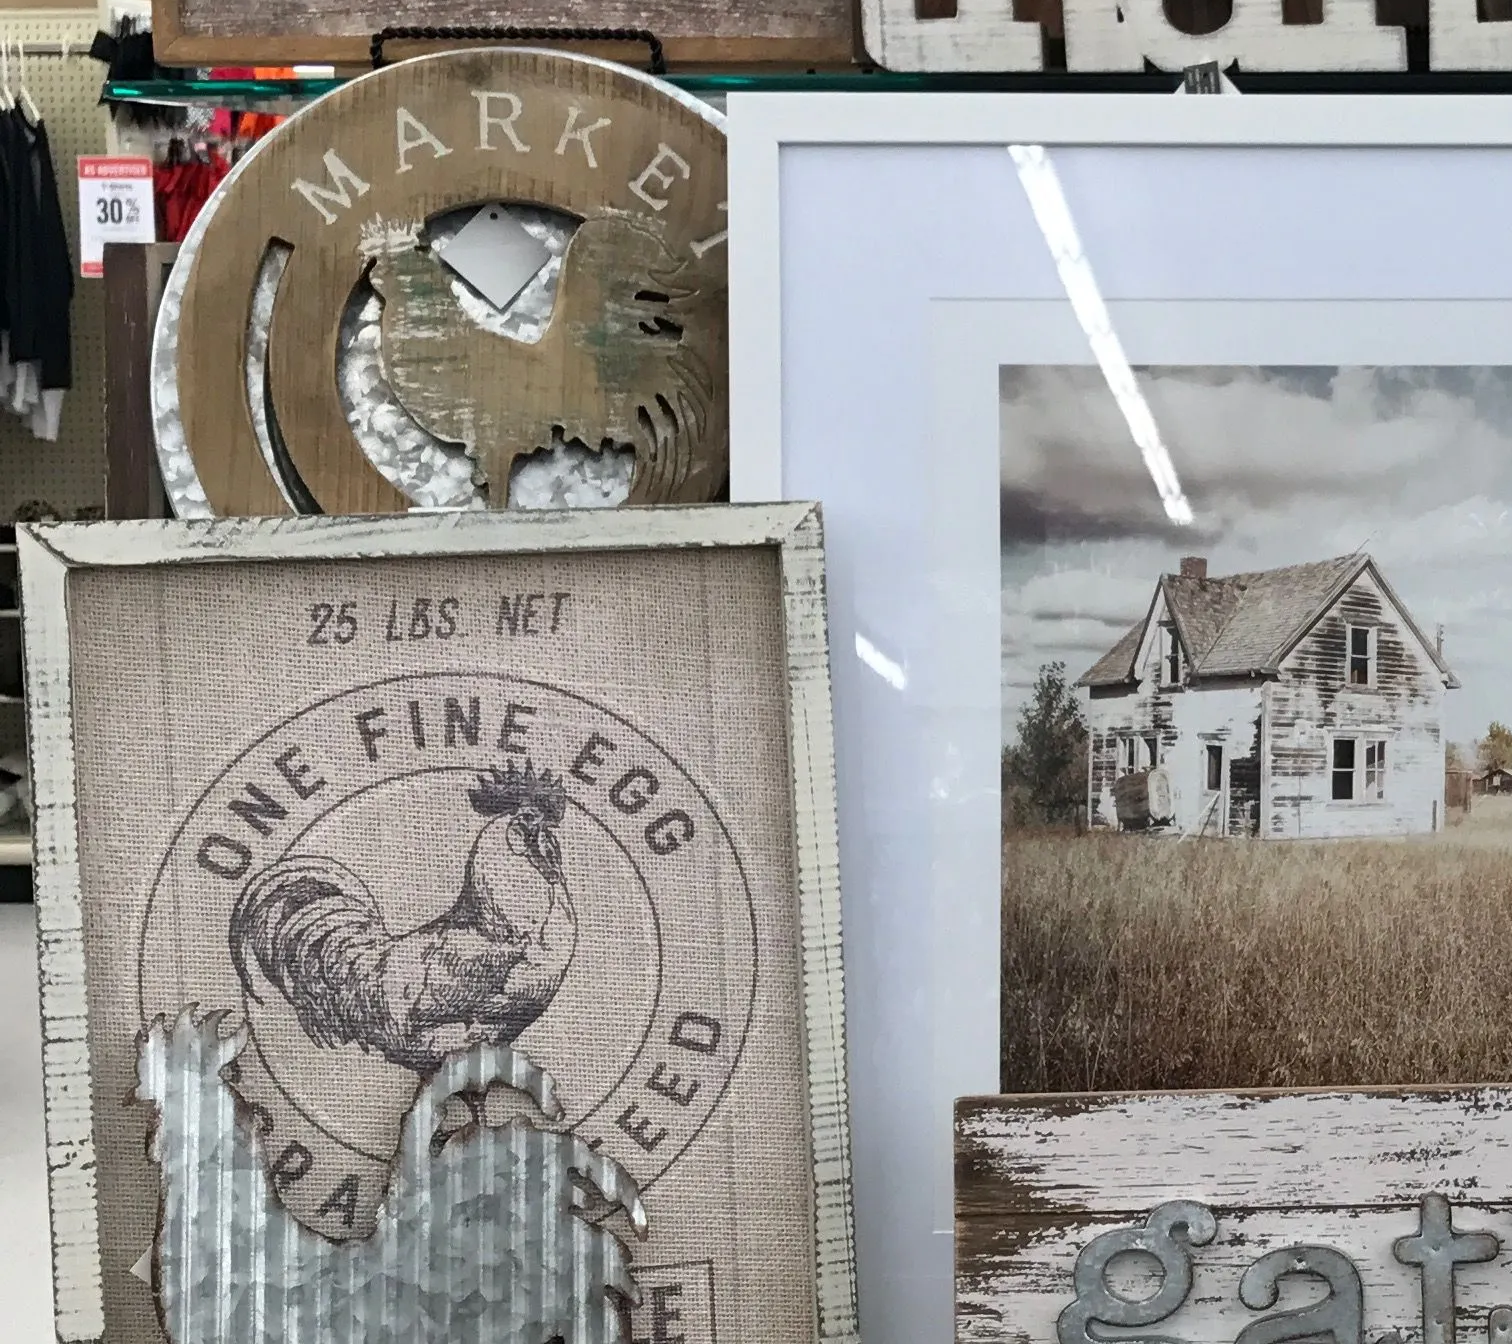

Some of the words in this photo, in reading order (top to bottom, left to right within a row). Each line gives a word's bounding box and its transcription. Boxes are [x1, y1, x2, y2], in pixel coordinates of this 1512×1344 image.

[306, 602, 358, 645] 25
[497, 592, 571, 636] NET
[197, 741, 328, 881] ONE
[354, 696, 537, 764] FINE
[569, 731, 697, 859] EGG
